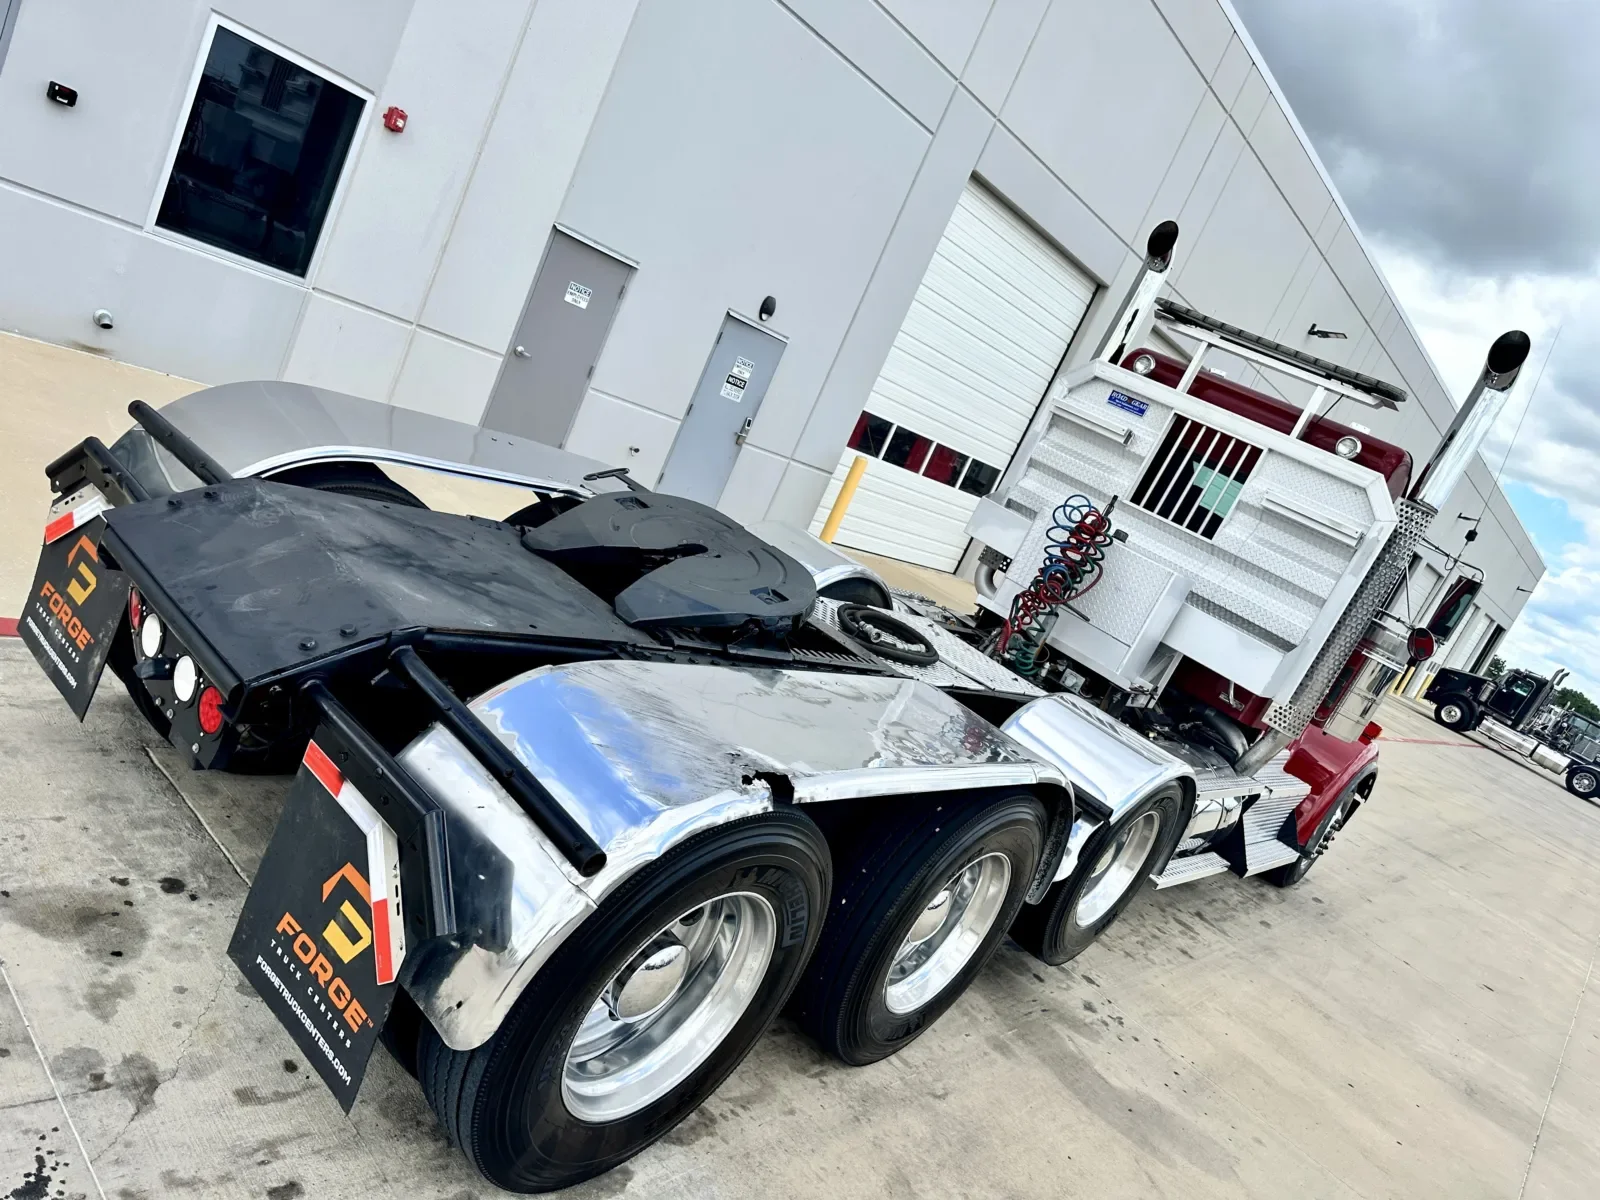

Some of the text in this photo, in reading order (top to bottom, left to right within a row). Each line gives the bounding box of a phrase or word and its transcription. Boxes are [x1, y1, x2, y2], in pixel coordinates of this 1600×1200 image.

[570, 282, 591, 297] NOTICE
[727, 376, 746, 388] NOTICE
[737, 358, 754, 368] NOTICE
[1111, 392, 1128, 402] ROAD
[1131, 400, 1148, 410] GEAR
[40, 581, 92, 651] FORGE
[54, 628, 80, 664] CENTERS
[757, 867, 806, 948] MICHELIN
[270, 939, 351, 1049] TRUCK CENTERS
[276, 911, 368, 1033] FORGE
[256, 954, 351, 1086] FORGETRUCKCENTERS.COM
